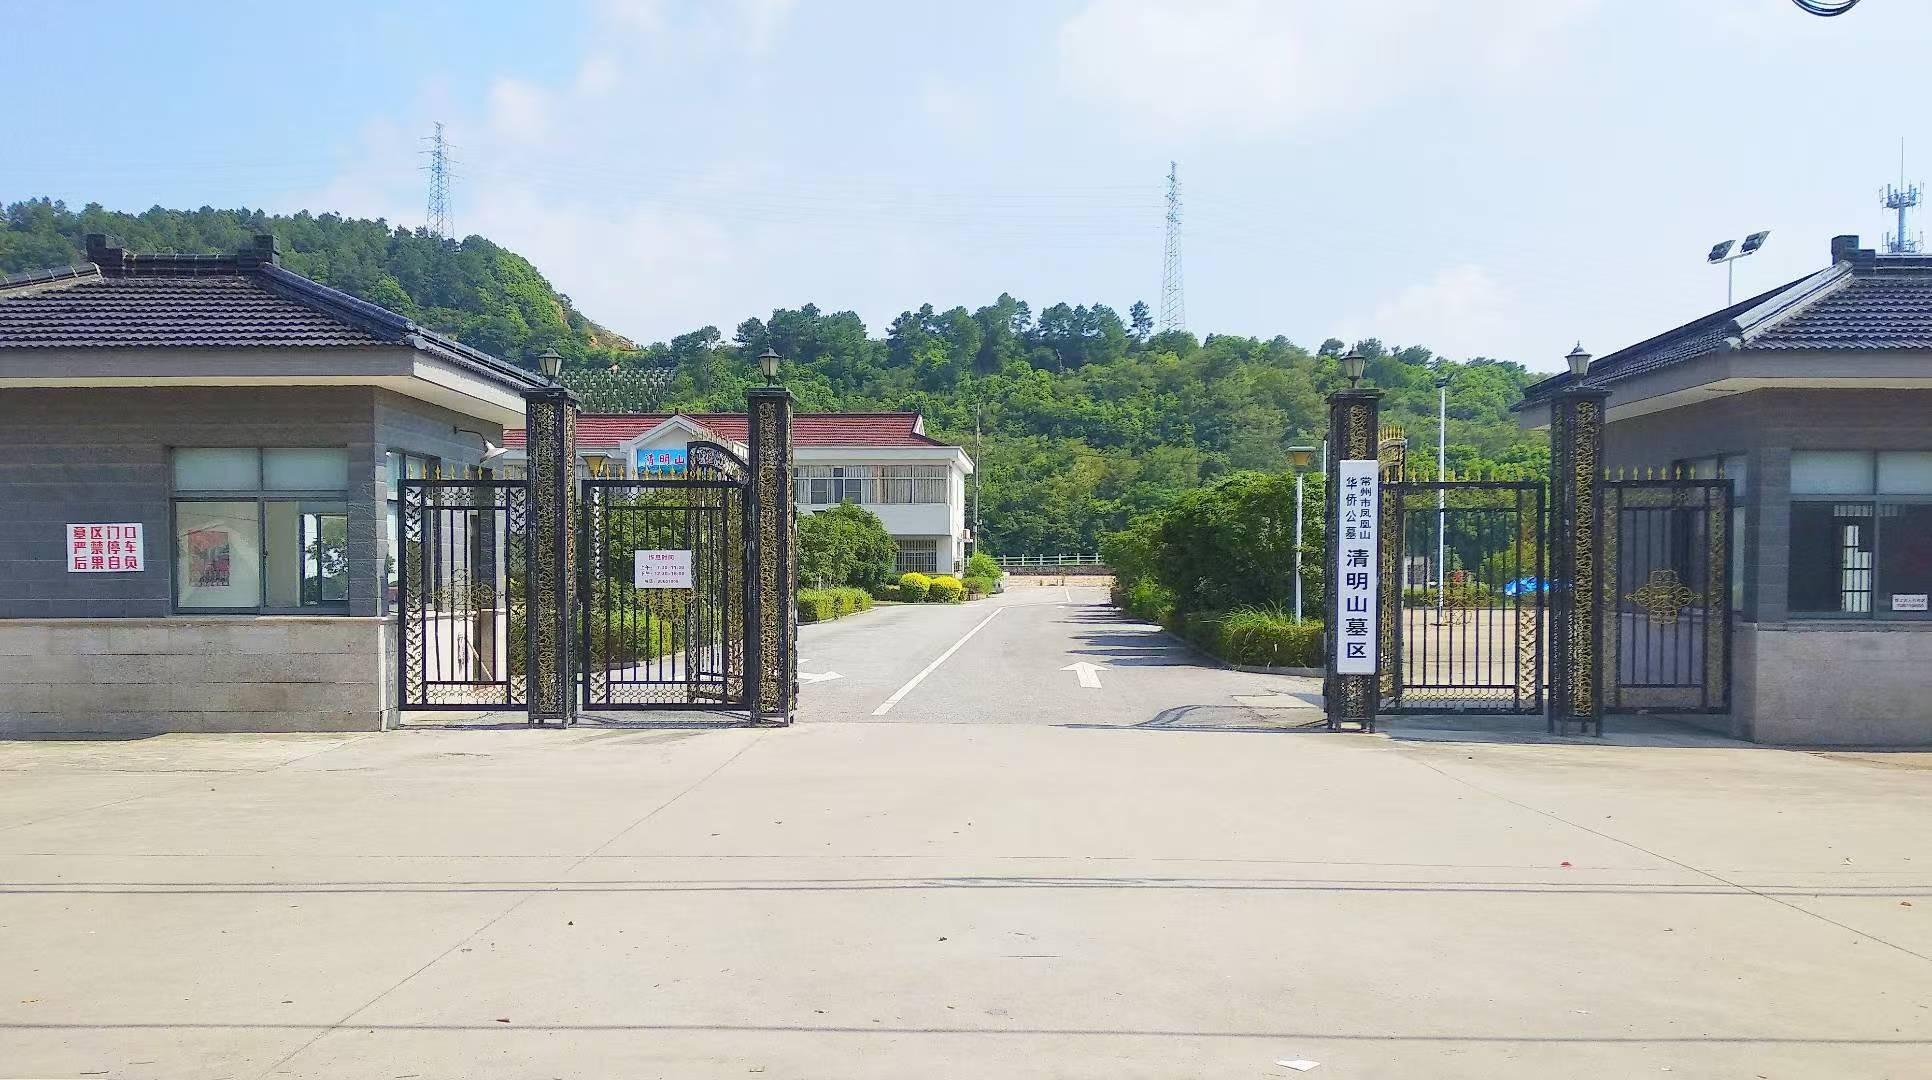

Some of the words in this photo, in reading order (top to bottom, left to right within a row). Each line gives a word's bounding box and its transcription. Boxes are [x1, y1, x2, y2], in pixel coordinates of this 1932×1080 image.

[1345, 476, 1358, 540] 华侨公墓
[1359, 476, 1372, 540] 常州市凤凰山
[73, 525, 137, 540] 墓区门口
[73, 540, 137, 555] 严禁停车
[74, 555, 138, 570] 后果自负
[1345, 548, 1370, 659] 清明山墓区
